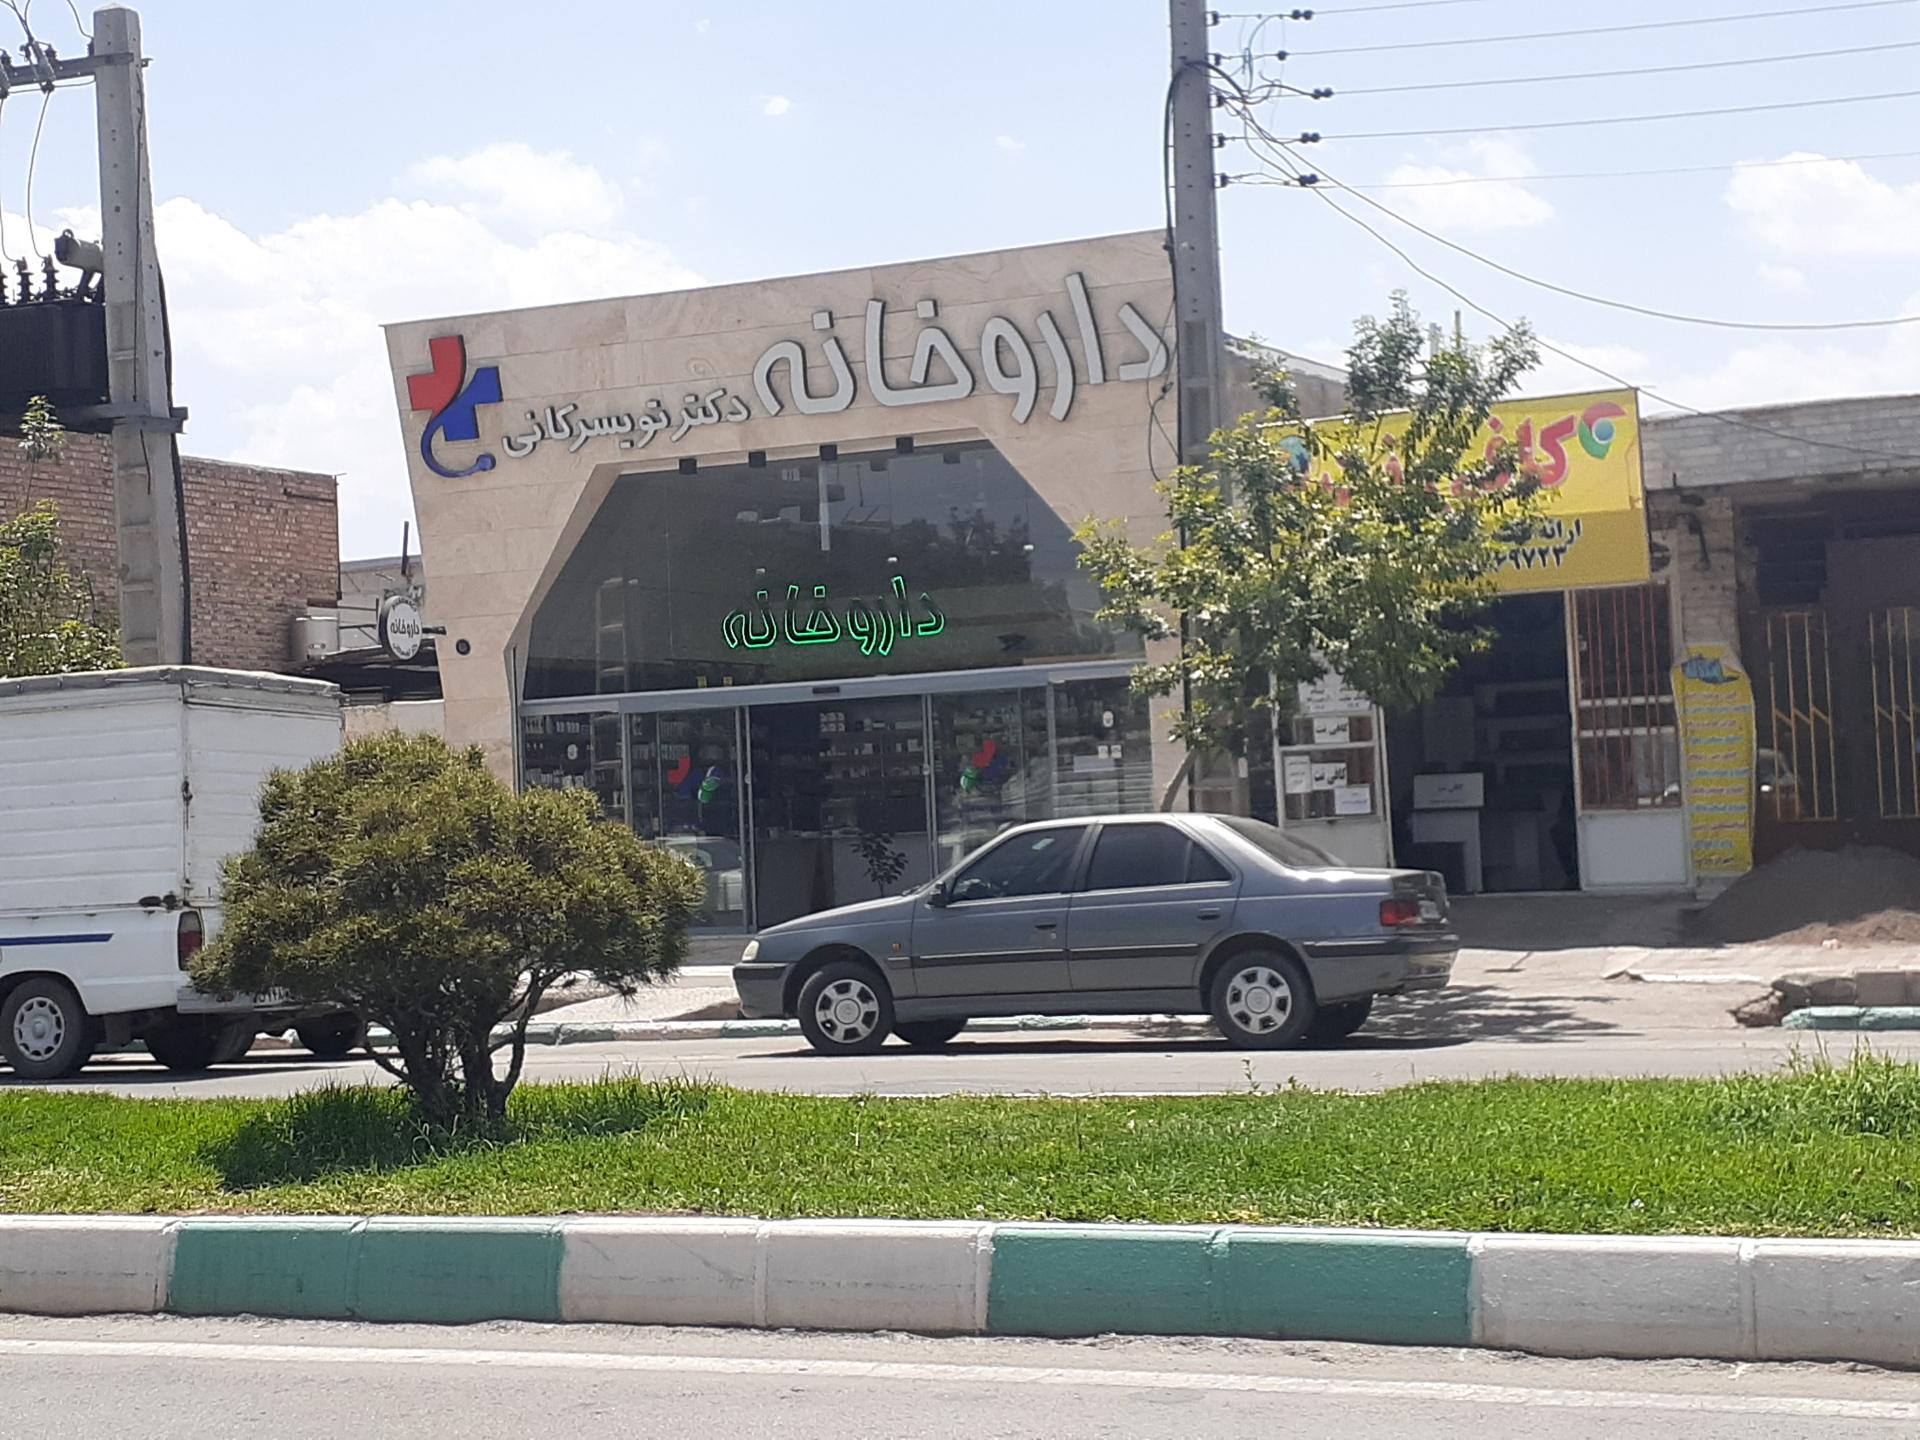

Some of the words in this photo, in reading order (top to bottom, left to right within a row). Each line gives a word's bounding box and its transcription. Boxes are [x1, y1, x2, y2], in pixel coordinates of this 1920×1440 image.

[753, 272, 1169, 424] داروخانه
[502, 399, 671, 458] تویسرکانی
[671, 387, 751, 442] دکتر
[390, 618, 420, 638] داروخانه
[722, 576, 945, 656] داروخانه
